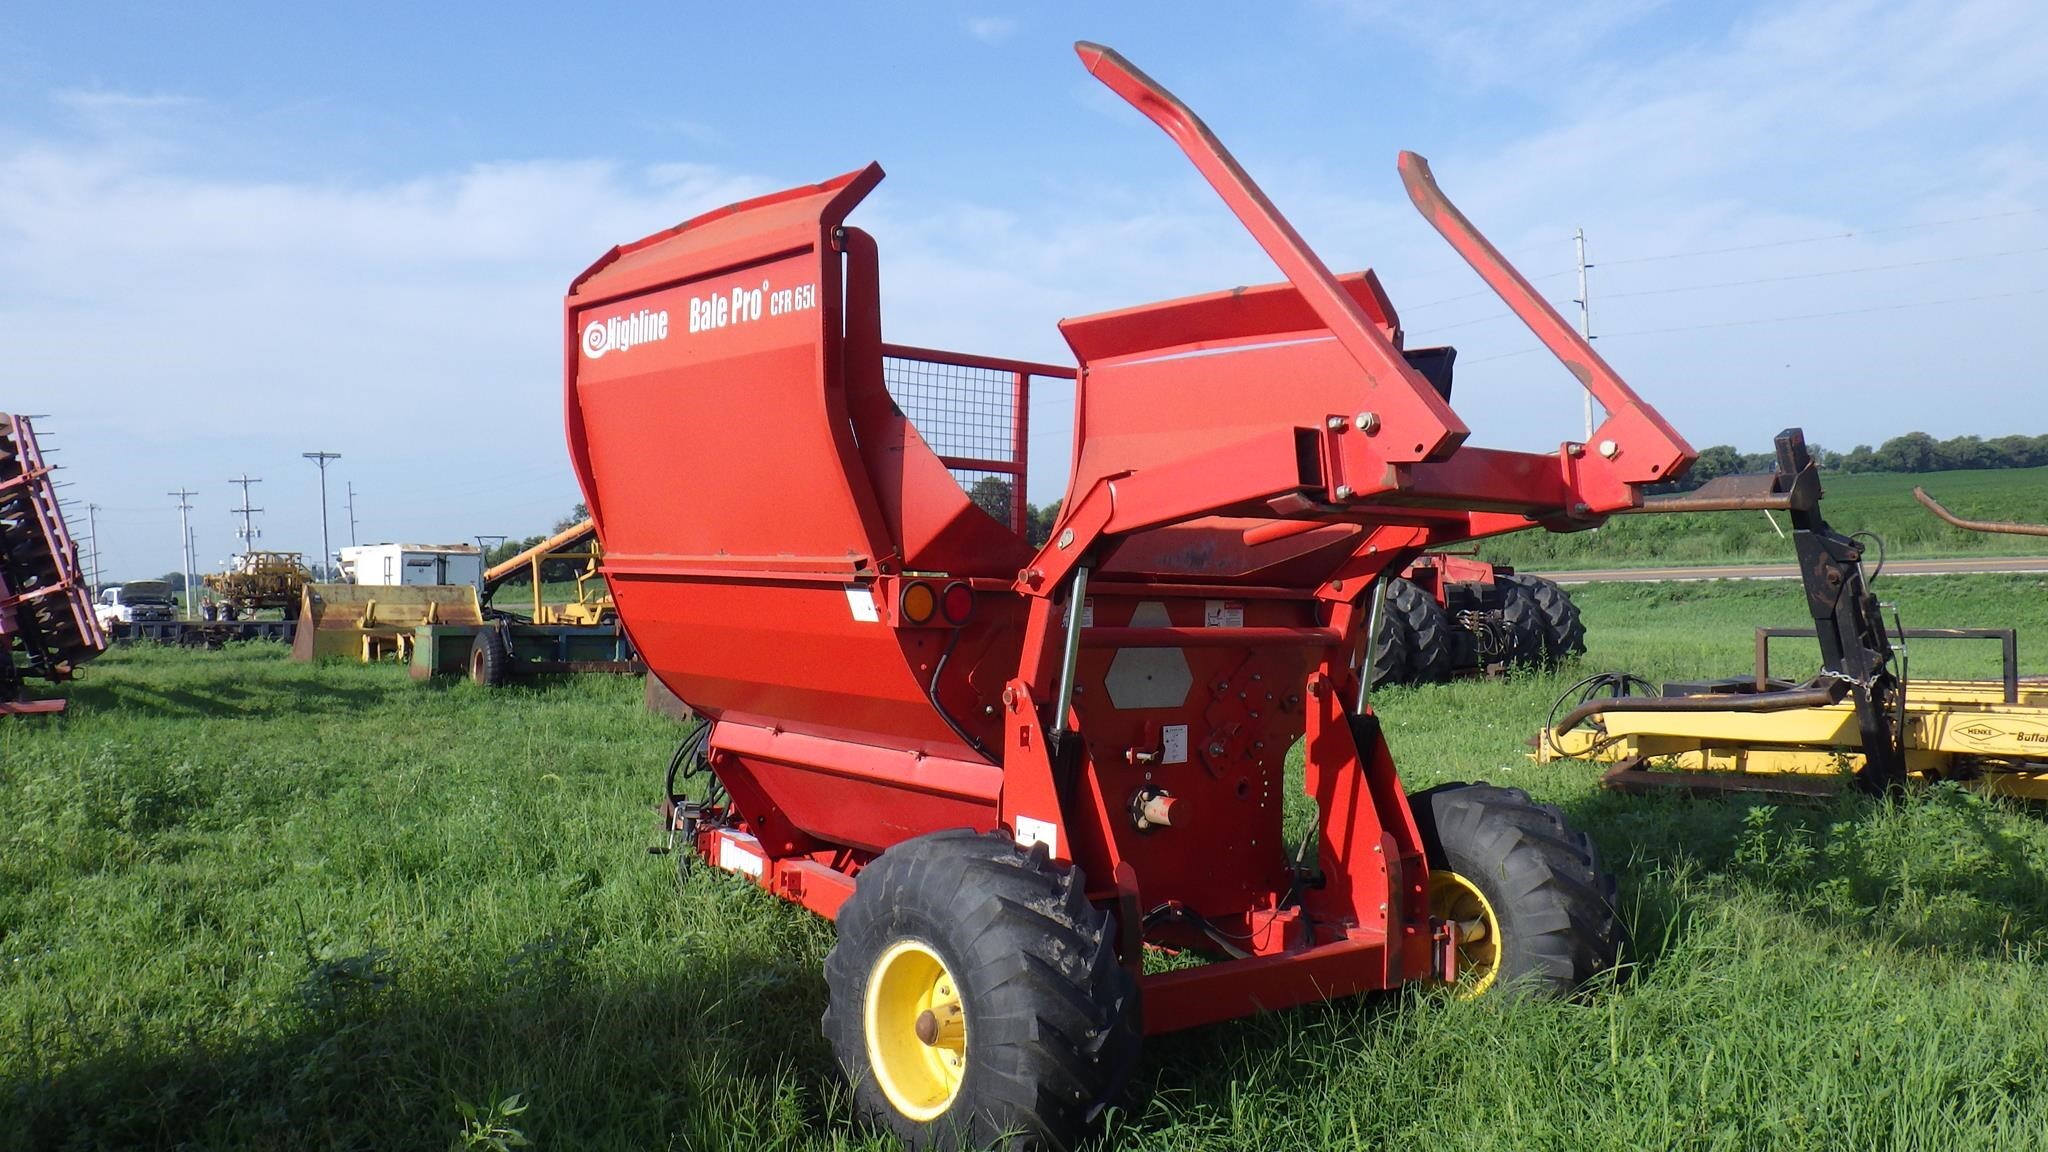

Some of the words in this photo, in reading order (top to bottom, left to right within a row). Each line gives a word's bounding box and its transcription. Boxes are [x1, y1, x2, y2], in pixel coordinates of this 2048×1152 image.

[606, 309, 668, 351] Highline
[690, 293, 728, 333] Bale
[771, 292, 791, 316] CFR
[1968, 728, 1992, 736] HENKE
